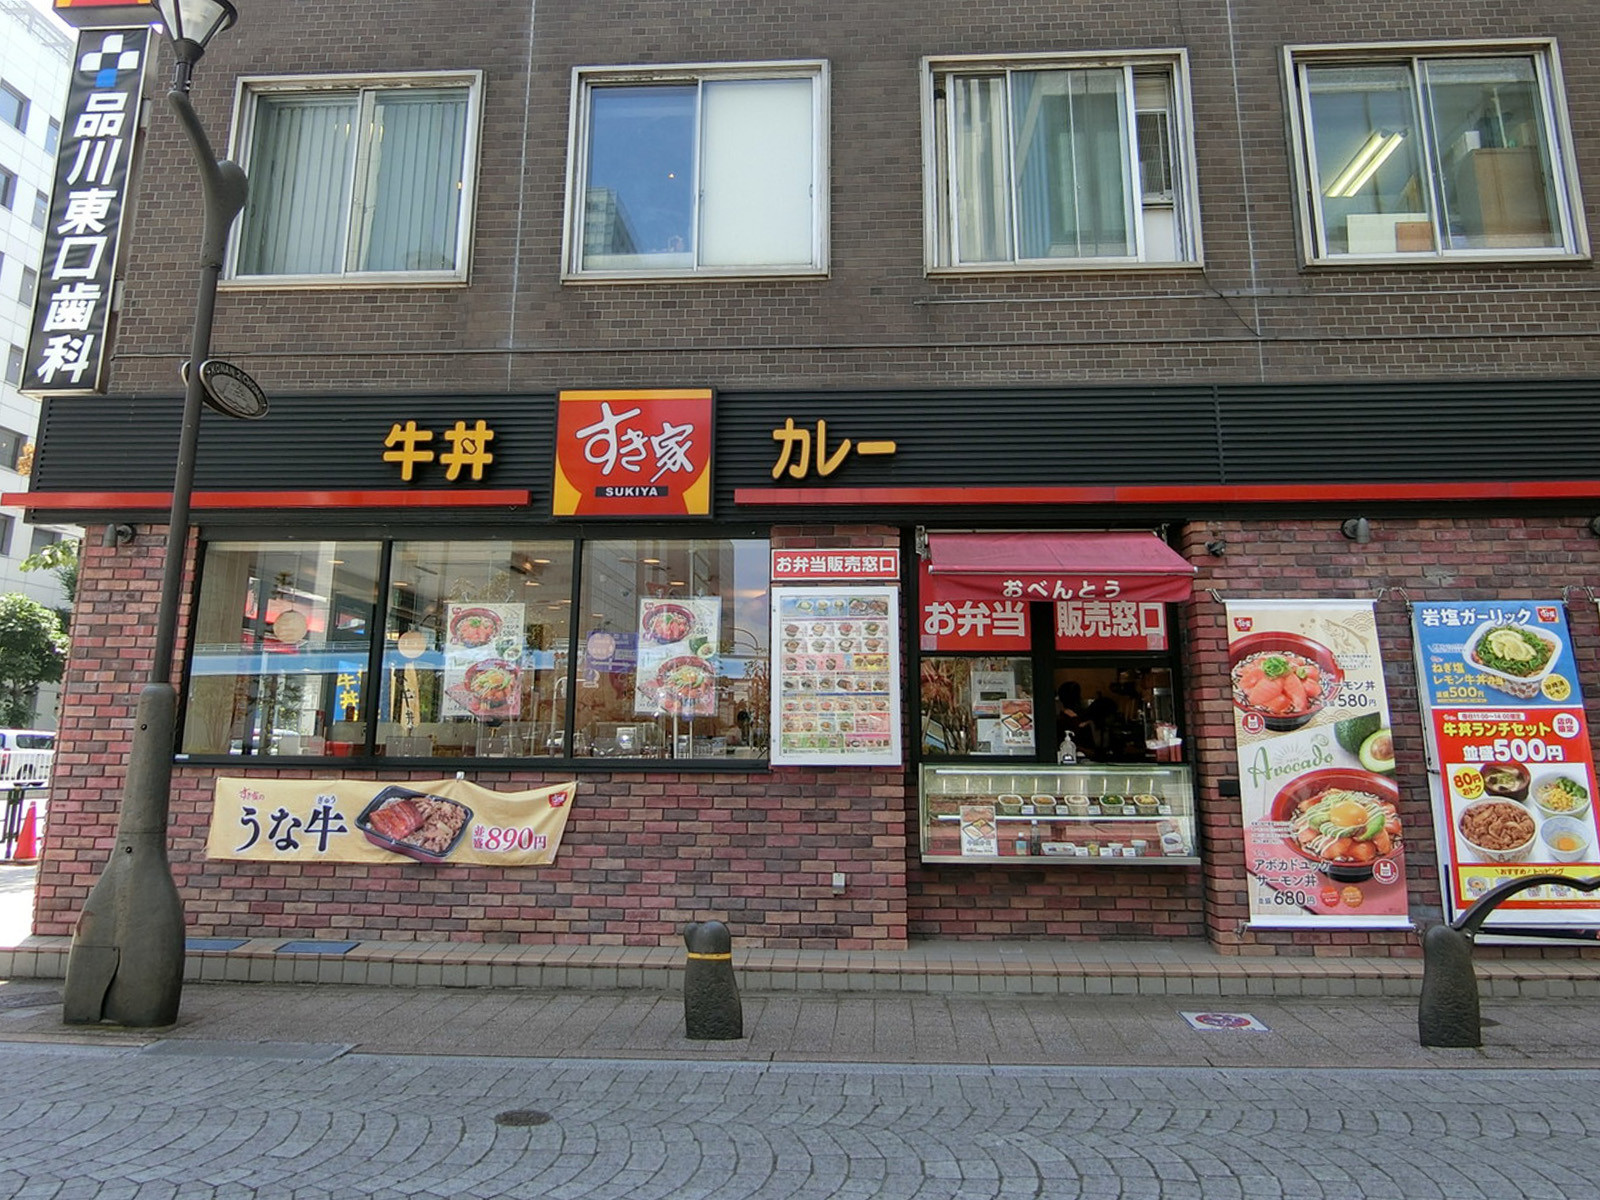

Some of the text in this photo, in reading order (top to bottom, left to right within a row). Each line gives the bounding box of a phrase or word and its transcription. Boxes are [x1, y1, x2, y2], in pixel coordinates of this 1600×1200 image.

[37, 92, 128, 384] 品川東口歯科
[383, 420, 495, 481] 牛丼
[576, 401, 695, 483] すき家
[772, 418, 896, 479] カレー
[605, 487, 658, 496] SUKIYA
[776, 555, 896, 572] お弁当販売窓口
[1003, 579, 1121, 599] おべんとう
[924, 601, 1165, 637] お弁当 販売窓口
[1422, 608, 1531, 627] 岩塩ガーリック
[1432, 662, 1465, 674] ねぎ塩
[1320, 680, 1375, 691] サーモン丼
[1443, 722, 1551, 737] 牛丼ランチセット
[1247, 744, 1334, 789] Avocado
[1453, 772, 1482, 788] 80円
[1462, 784, 1481, 796] おトク
[235, 805, 348, 852] うな牛
[1255, 859, 1332, 872] アボカドユッケ
[1256, 874, 1317, 887] サーモン丼
